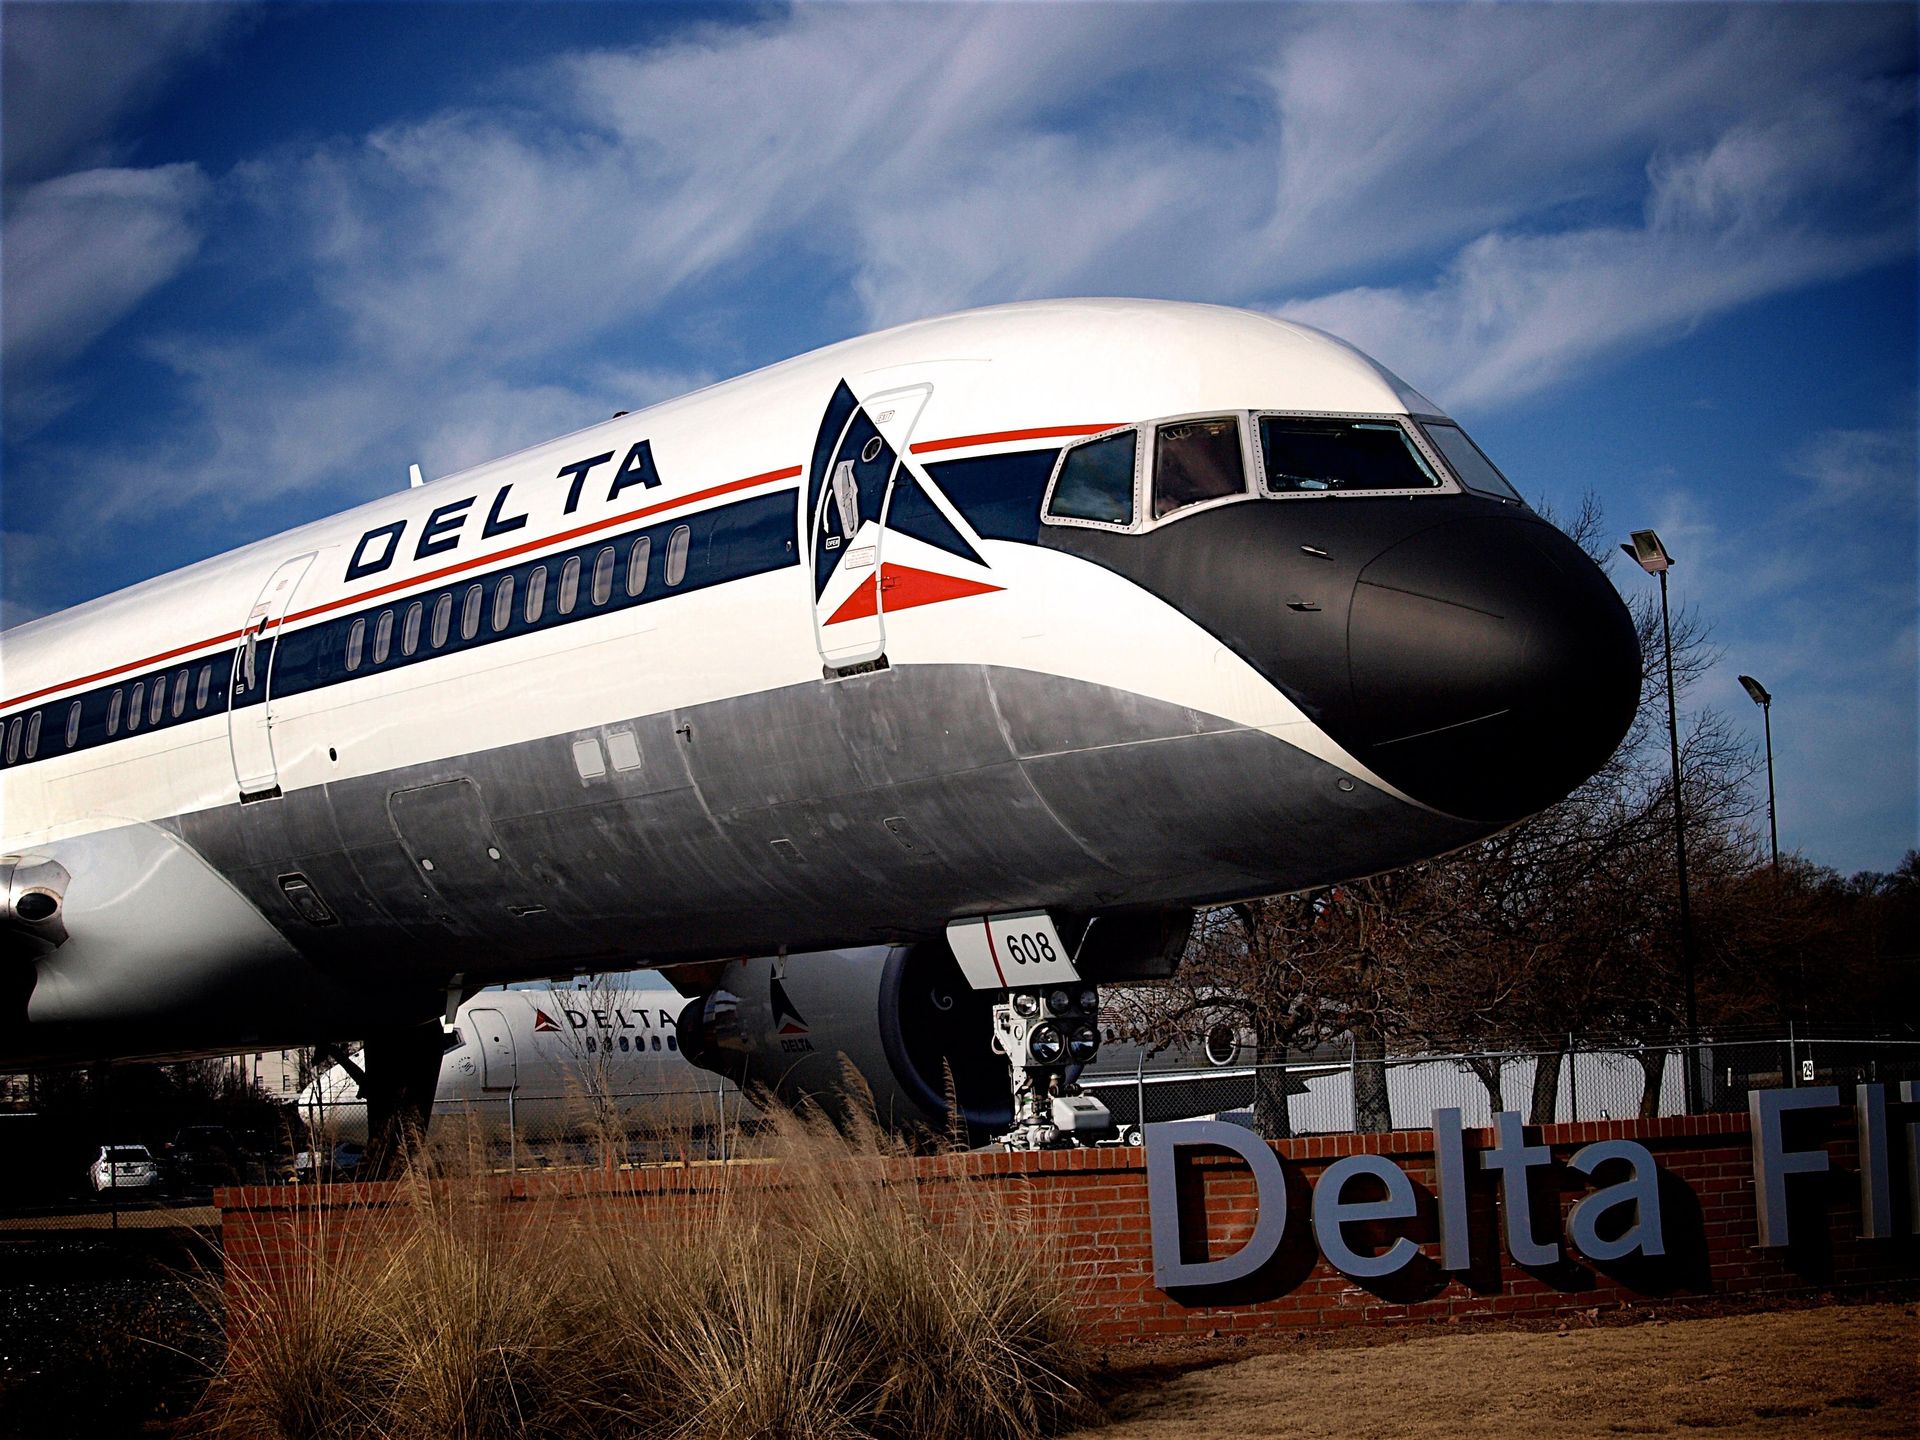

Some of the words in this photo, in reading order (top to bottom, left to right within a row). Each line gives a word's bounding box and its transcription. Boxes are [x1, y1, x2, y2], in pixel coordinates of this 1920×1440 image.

[344, 439, 662, 582] DELTA
[1006, 932, 1057, 965] 608
[564, 1009, 678, 1029] DELTA
[780, 1037, 815, 1053] DELTA
[1803, 1062, 1813, 1078] 29
[1144, 1106, 1666, 1289] Delta
